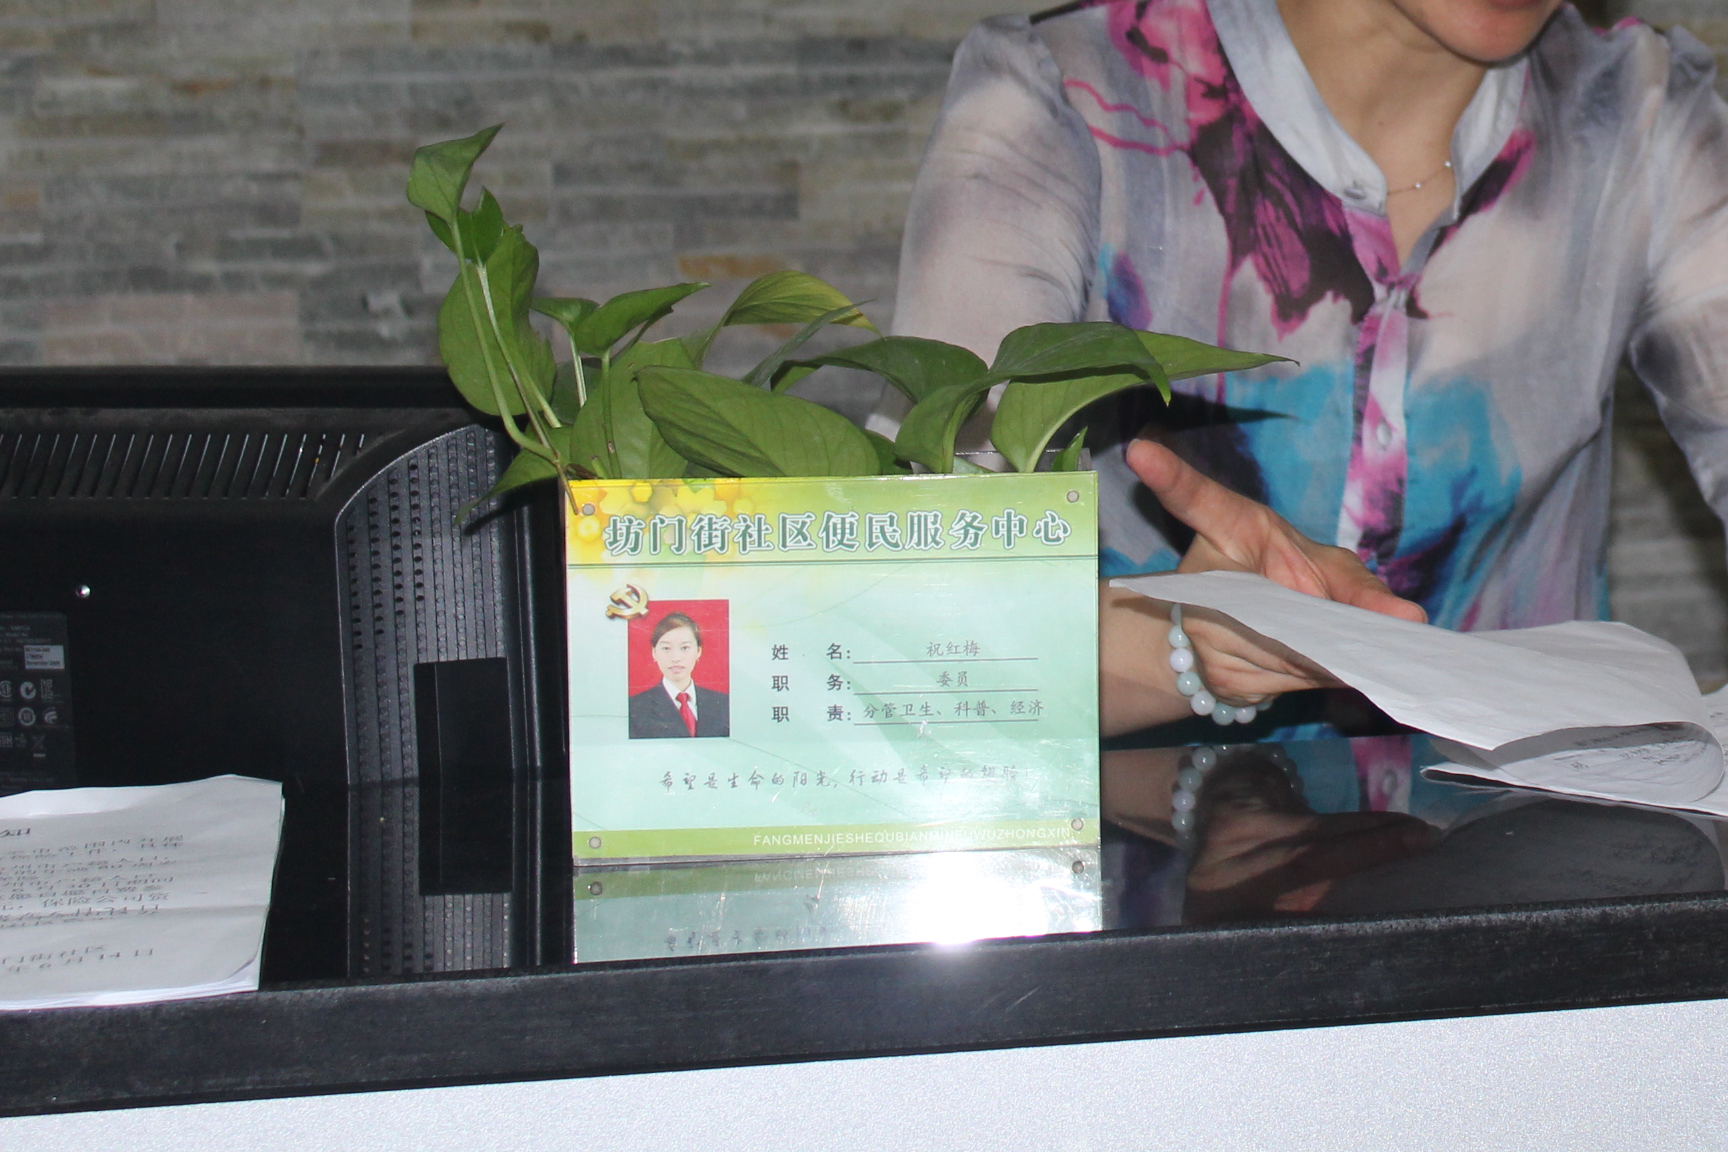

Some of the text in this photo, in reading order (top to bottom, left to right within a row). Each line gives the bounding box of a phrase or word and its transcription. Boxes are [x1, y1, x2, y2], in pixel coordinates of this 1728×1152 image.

[604, 508, 1073, 556] 坊门街社区便民服务中心
[925, 640, 982, 658] 祝红梅
[936, 670, 970, 688] 委员
